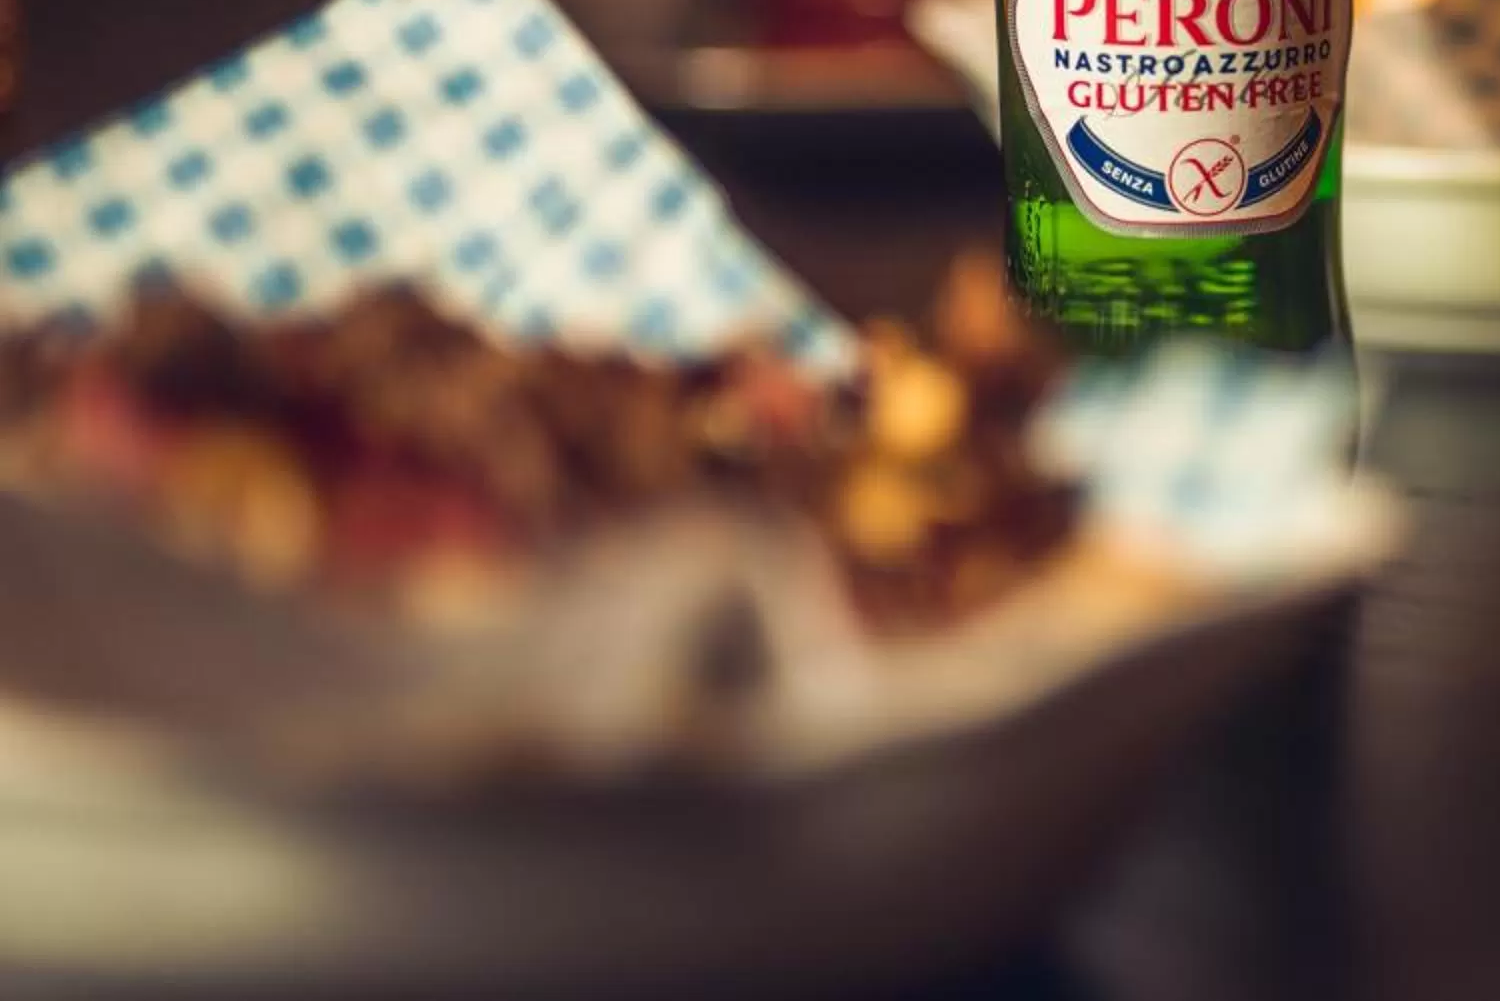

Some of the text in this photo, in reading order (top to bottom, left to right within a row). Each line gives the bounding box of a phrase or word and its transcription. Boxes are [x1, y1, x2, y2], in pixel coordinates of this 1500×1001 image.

[1055, 39, 1331, 76] NASTRO AZZURRO
[1067, 79, 1235, 112] GLUTEN
[1246, 70, 1322, 106] FREE
[1100, 140, 1309, 196] SENZA GLUTINE
